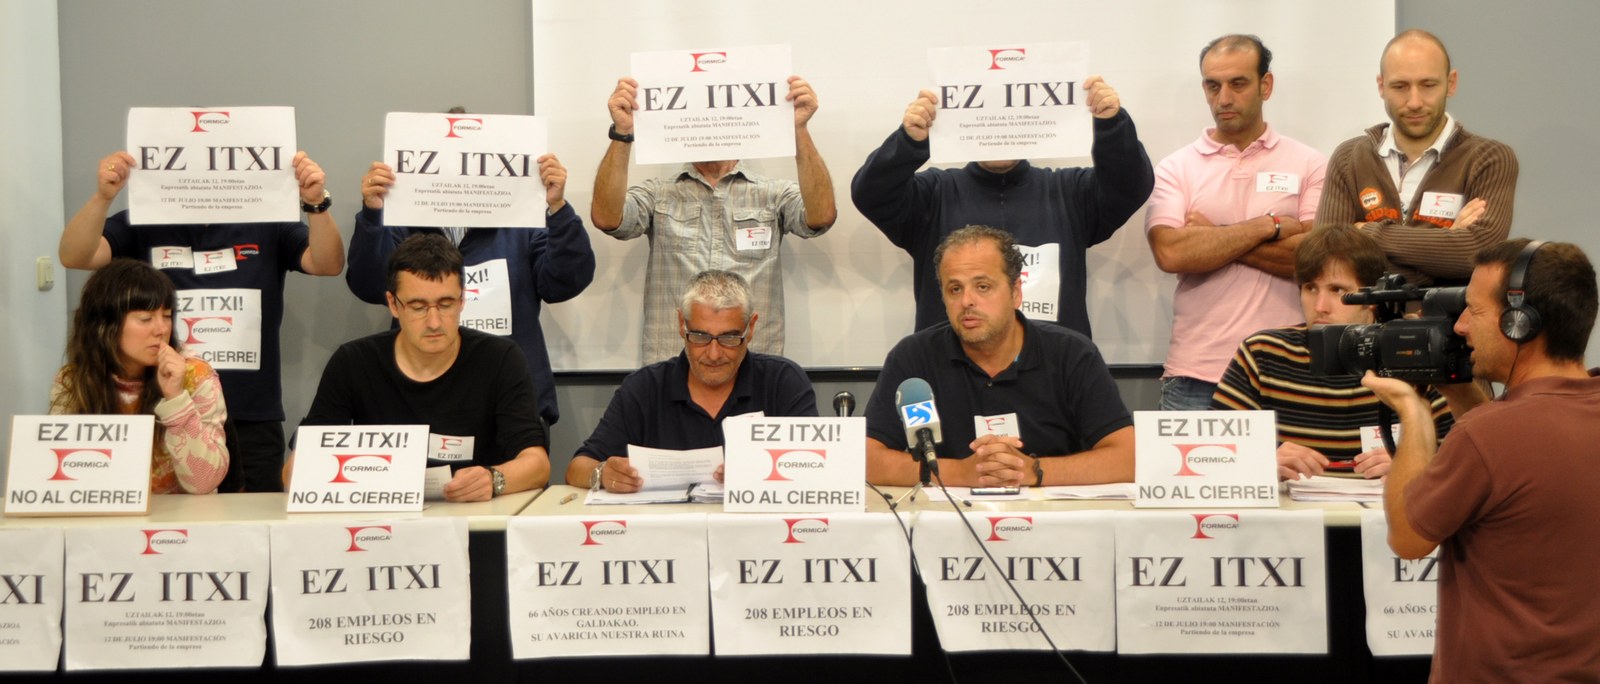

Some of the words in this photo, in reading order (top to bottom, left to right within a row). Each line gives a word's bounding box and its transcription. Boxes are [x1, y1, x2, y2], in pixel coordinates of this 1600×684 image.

[643, 86, 687, 111] EZ
[705, 82, 778, 109] ITXI
[939, 85, 984, 109] EZ
[1003, 81, 1076, 108] ITXI
[139, 146, 187, 171] EZ
[206, 146, 283, 171] ITXI
[395, 150, 440, 175] EZ
[459, 152, 532, 177] ITXI
[1019, 253, 1039, 266] XI!
[467, 268, 489, 284] XI!
[201, 296, 244, 311] ITXI!
[1022, 301, 1053, 314] RRE!
[459, 318, 508, 330] IERRE!
[202, 351, 257, 363] CIERRE!
[37, 423, 69, 441] EZ
[76, 423, 129, 442] ITXI!
[751, 424, 781, 442] EZ
[789, 424, 841, 442] ITXI!
[1158, 419, 1189, 436] EZ
[1197, 418, 1251, 436] ITXI!
[320, 432, 351, 448] EZ
[358, 432, 409, 448] ITXI!
[11, 490, 38, 504] NO
[42, 490, 65, 504] AL
[70, 490, 142, 504] CIERRE!
[292, 492, 318, 504] NO
[322, 492, 345, 504] AL
[349, 492, 420, 504] CIERRE!
[728, 490, 755, 505] NO
[760, 490, 783, 505] AL
[787, 490, 860, 505] CIERRE!
[1139, 485, 1166, 499] NO
[1172, 485, 1194, 499] AL
[1200, 485, 1274, 499] CIERRE!
[536, 561, 582, 587] EZ
[601, 559, 677, 586] ITXI
[737, 559, 784, 584] EZ
[802, 558, 879, 583] ITXI
[939, 557, 986, 581] EZ
[1005, 557, 1082, 581] ITXI
[1128, 557, 1187, 587] EZ
[1210, 557, 1306, 587] ITXI
[1392, 556, 1439, 582] EZ
[79, 572, 136, 603] EZ
[159, 571, 252, 601] ITXI
[300, 568, 347, 595] EZ
[366, 564, 442, 591] ITXI
[0, 575, 46, 604] XI
[528, 610, 538, 618] 66
[541, 607, 569, 617] AÑOS
[572, 607, 623, 616] CREANDO
[626, 606, 670, 615] EMPLEO
[672, 606, 687, 614] EN
[745, 608, 768, 620] 208
[773, 607, 847, 619] EMPLEOS
[852, 606, 873, 618] EN
[947, 604, 970, 616] 208
[974, 604, 1050, 615] EMPLEOS
[1055, 604, 1076, 615] EN
[1384, 606, 1394, 615] 66
[1397, 604, 1426, 614] AÑOS
[309, 618, 332, 630] 208
[337, 613, 412, 628] EMPLEOS
[417, 612, 437, 624] EN
[576, 619, 639, 628] GALDAKAO.
[981, 621, 1042, 633] RIESGO
[344, 631, 404, 646] RIESGO
[531, 634, 543, 642] SU
[548, 632, 598, 641] AVARICIA
[601, 630, 649, 639] NUESTRA
[652, 629, 685, 638] RUINA
[780, 625, 839, 637] RIESGO
[1387, 630, 1400, 639] SU
[1403, 629, 1437, 638] AVAR
